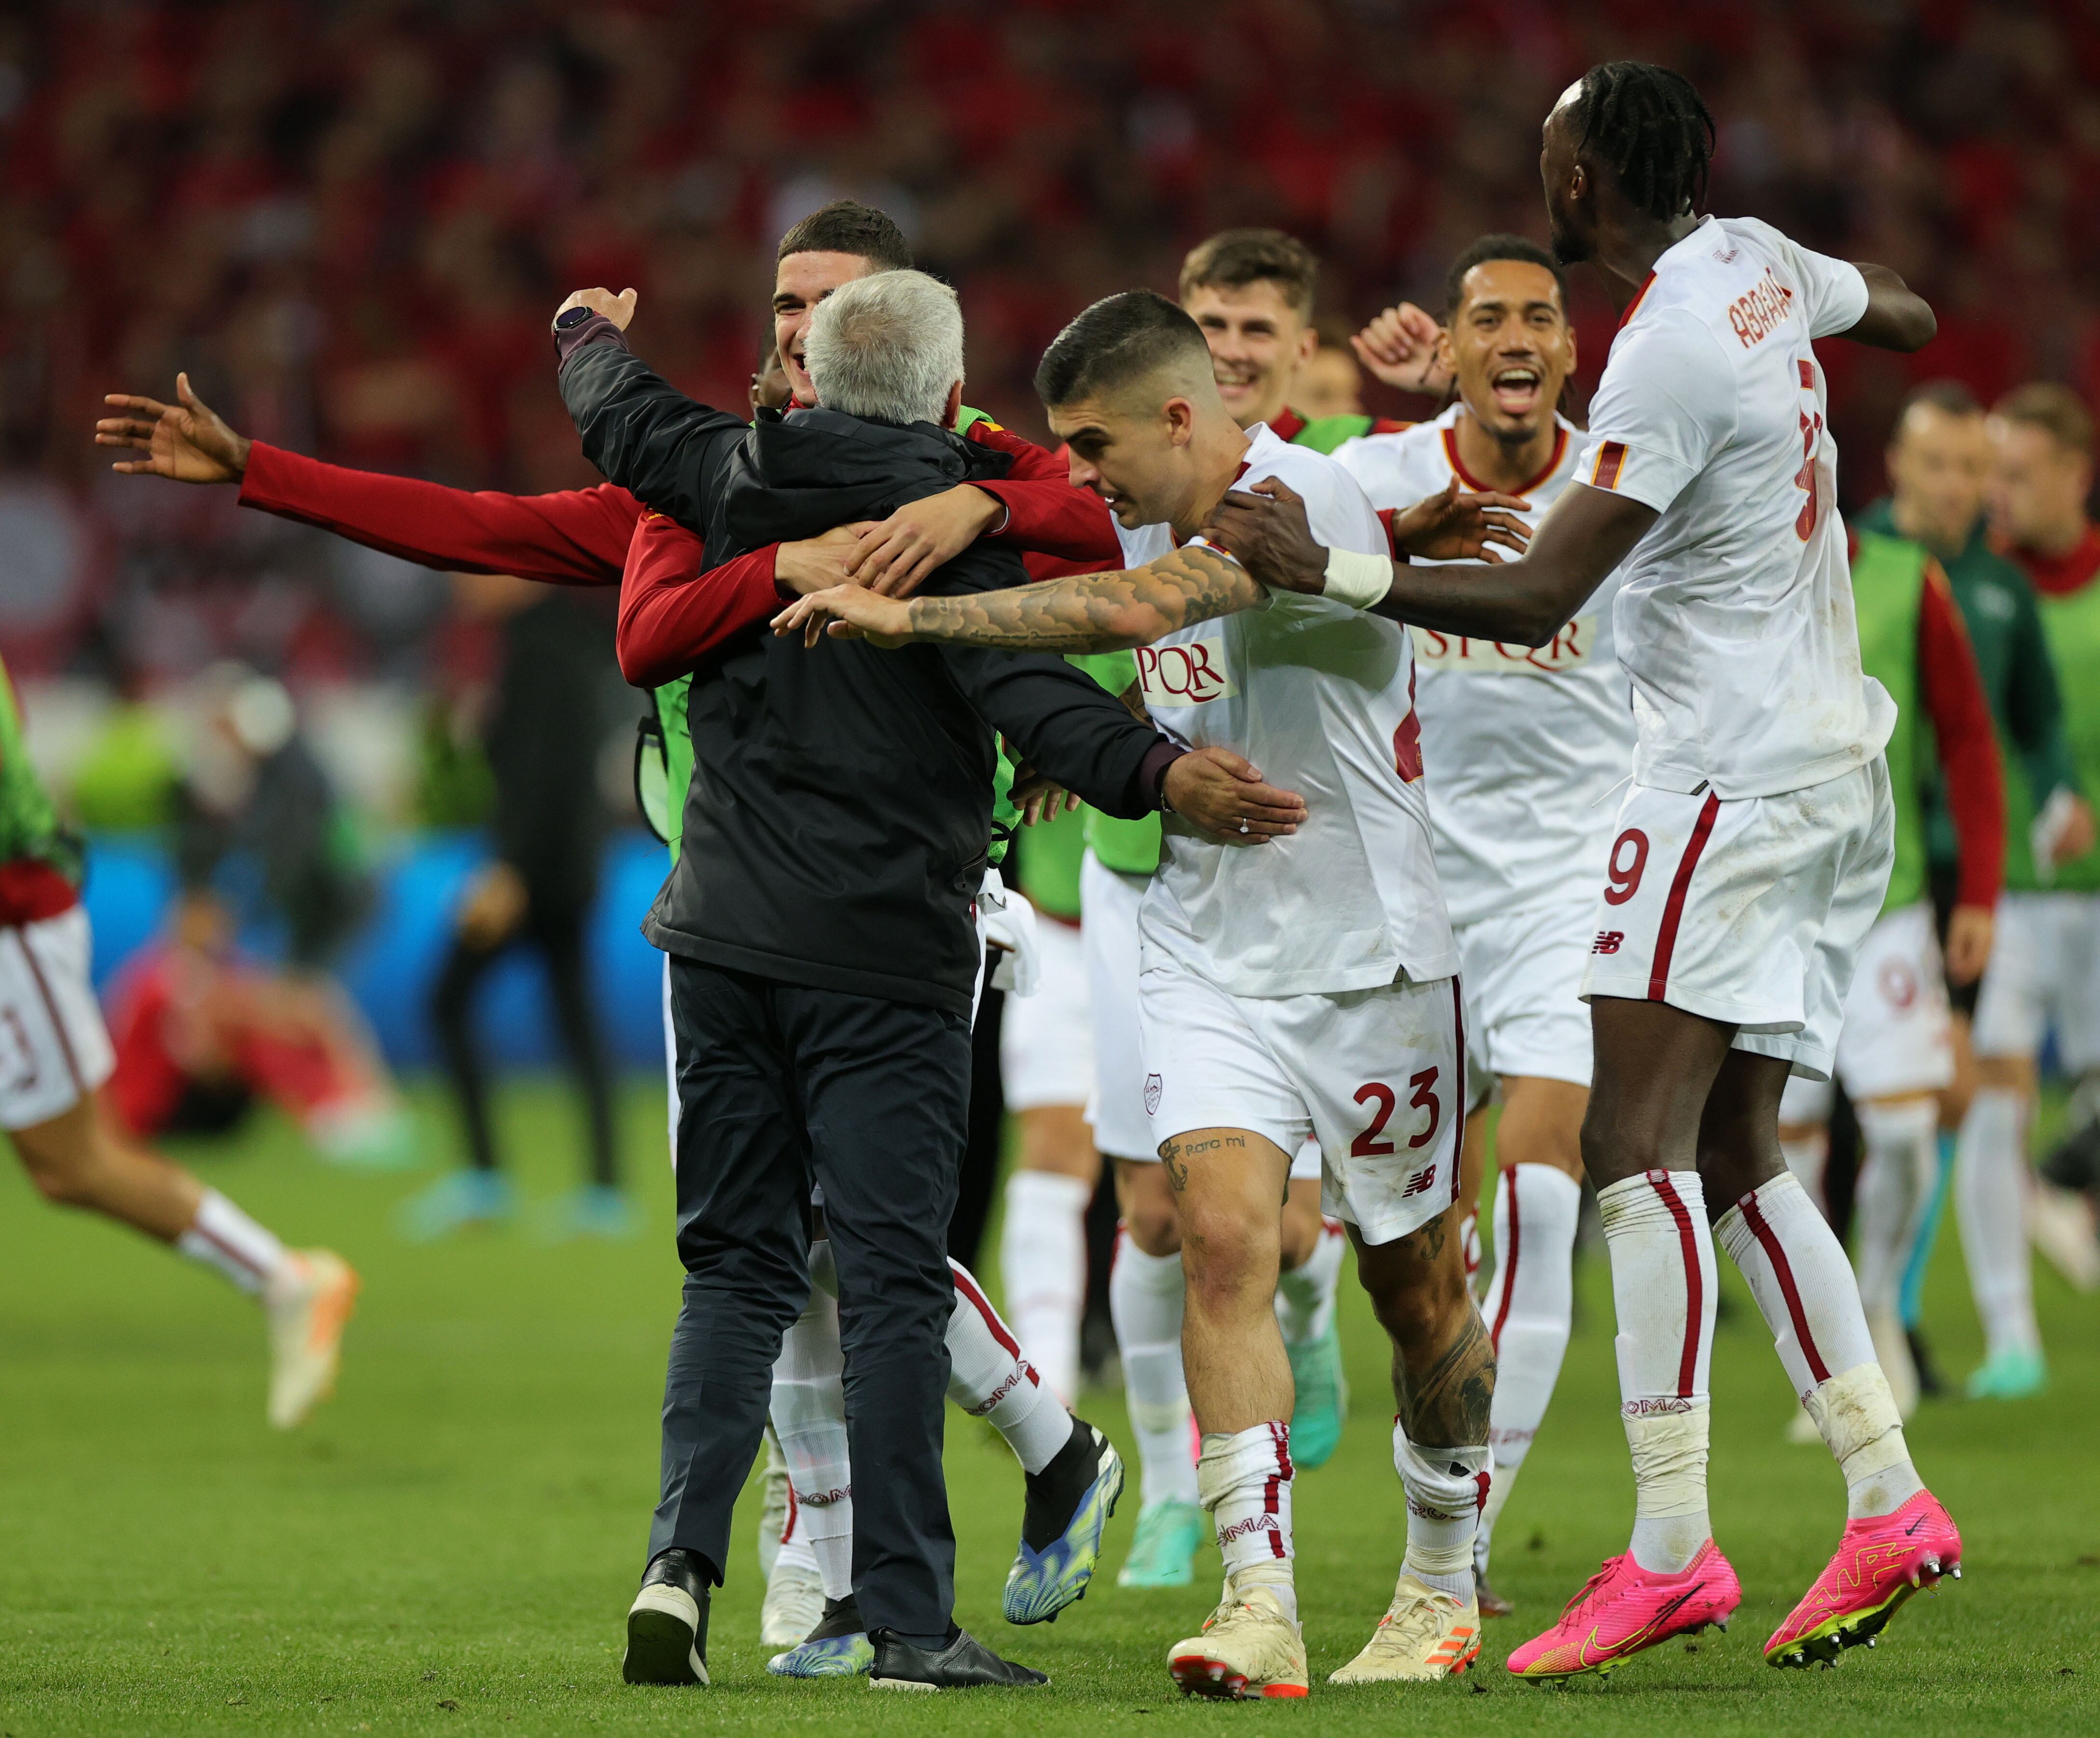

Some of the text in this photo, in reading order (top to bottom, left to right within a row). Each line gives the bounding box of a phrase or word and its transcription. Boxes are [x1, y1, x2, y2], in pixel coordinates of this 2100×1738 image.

[1604, 828, 1649, 906] 9
[1226, 1135, 1246, 1148] mi
[1351, 1065, 1440, 1158] 23
